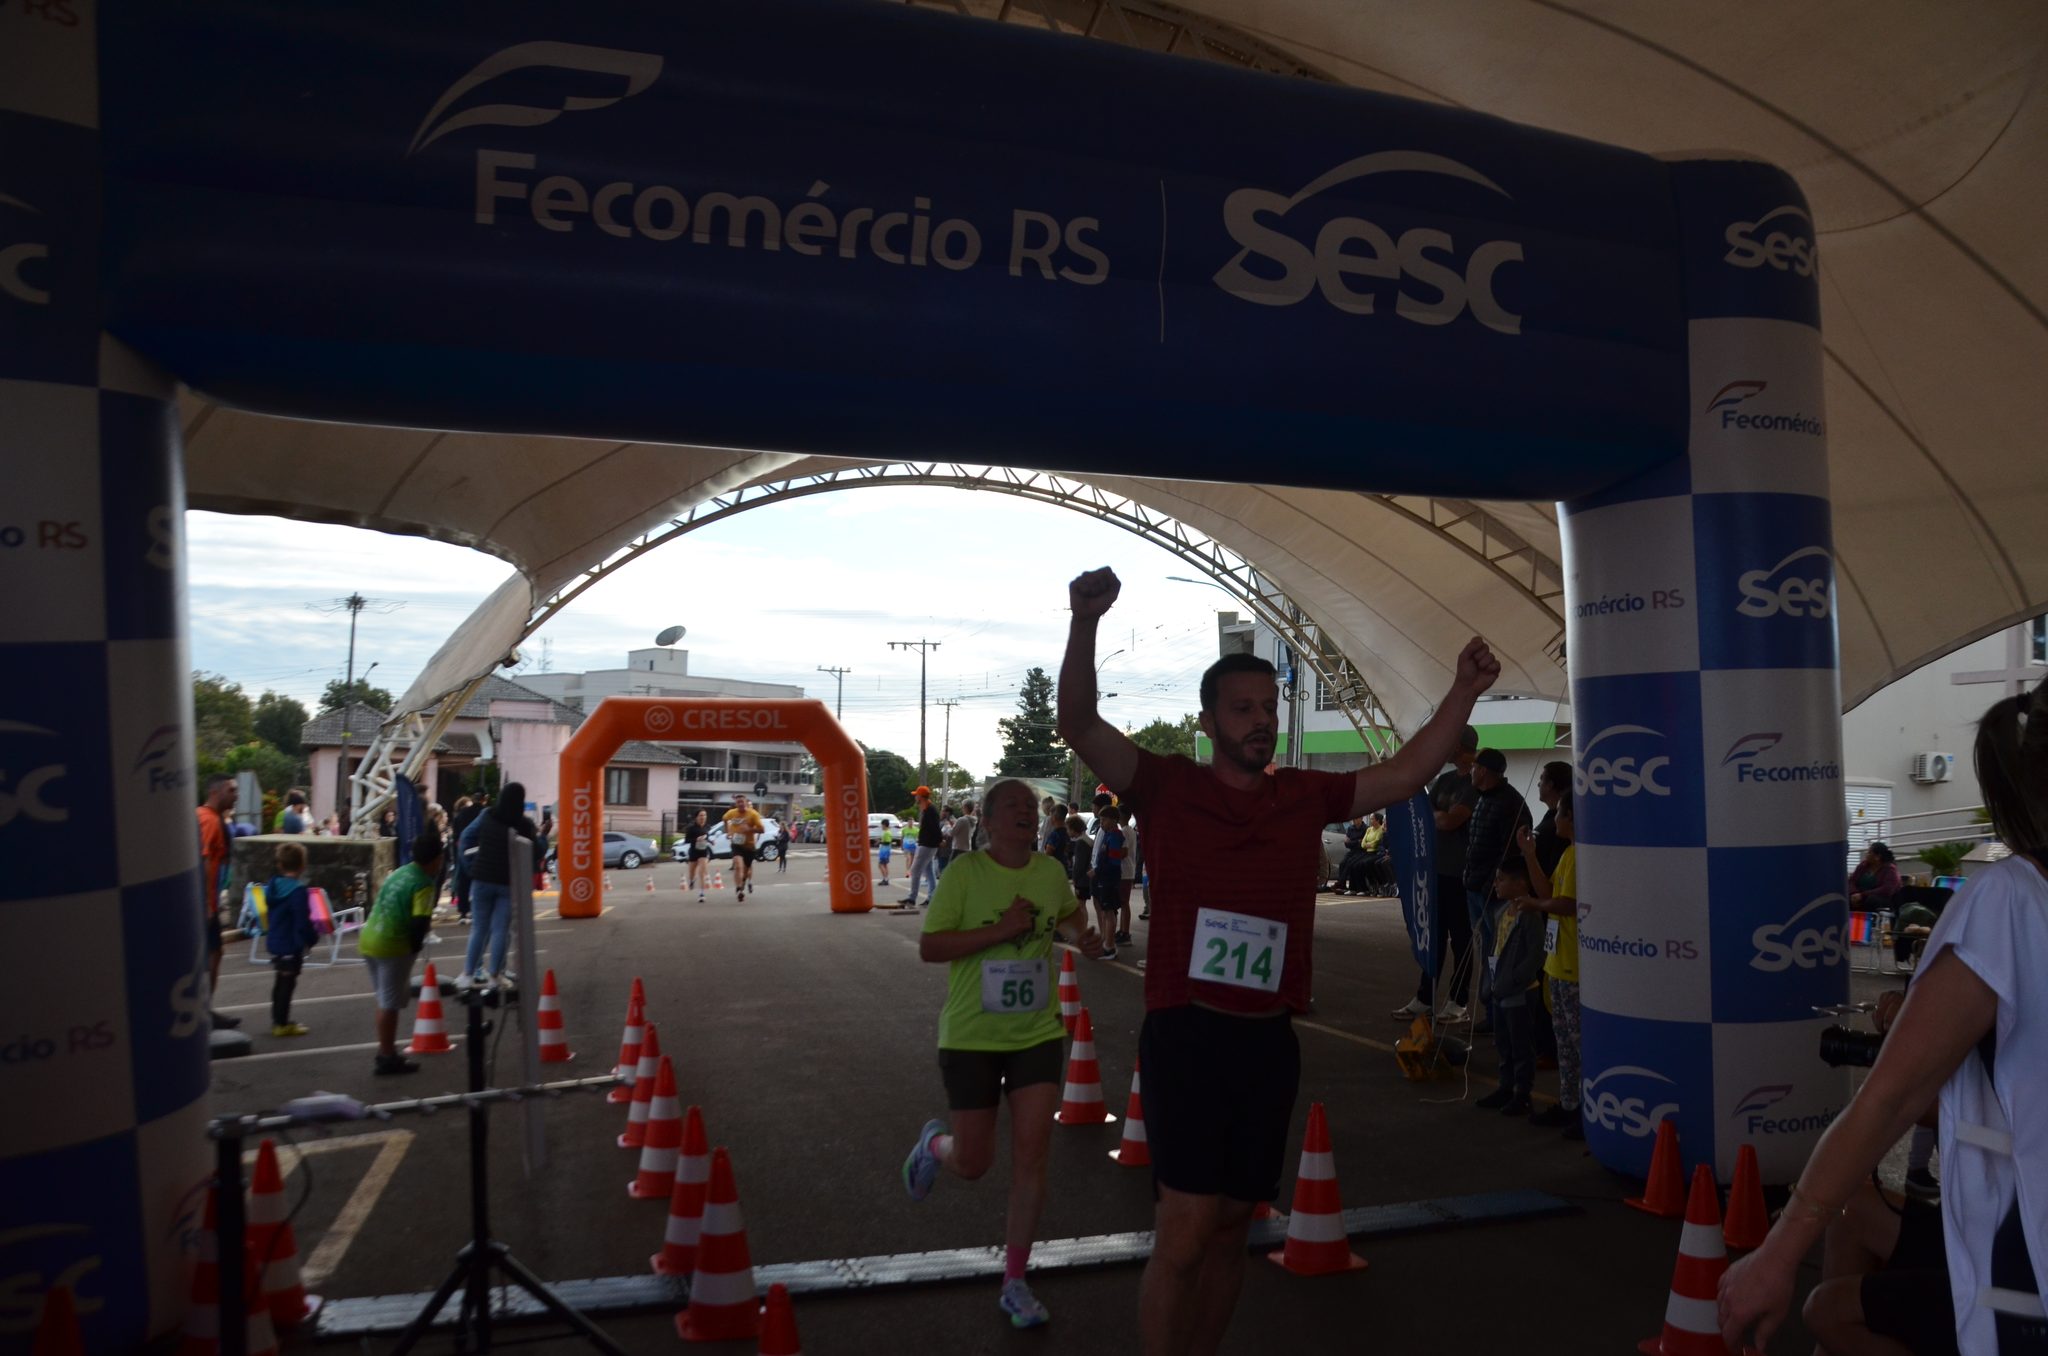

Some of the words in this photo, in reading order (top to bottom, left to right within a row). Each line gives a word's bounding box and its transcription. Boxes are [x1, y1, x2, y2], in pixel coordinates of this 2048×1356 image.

[474, 147, 982, 271] Fecomércio
[1009, 208, 1110, 286] RS
[1212, 150, 1524, 335] Sesc
[38, 520, 88, 549] RS
[1651, 588, 1686, 610] RS
[1736, 546, 1833, 619] Ses
[682, 708, 789, 731] CRESOL
[573, 782, 592, 870] CRESOL
[844, 777, 863, 865] CRESOL
[1413, 870, 1431, 953] Sesc
[1202, 936, 1272, 984] 214
[1664, 939, 1699, 960] RS
[1002, 979, 1034, 1008] 56
[68, 1020, 116, 1055] RS
